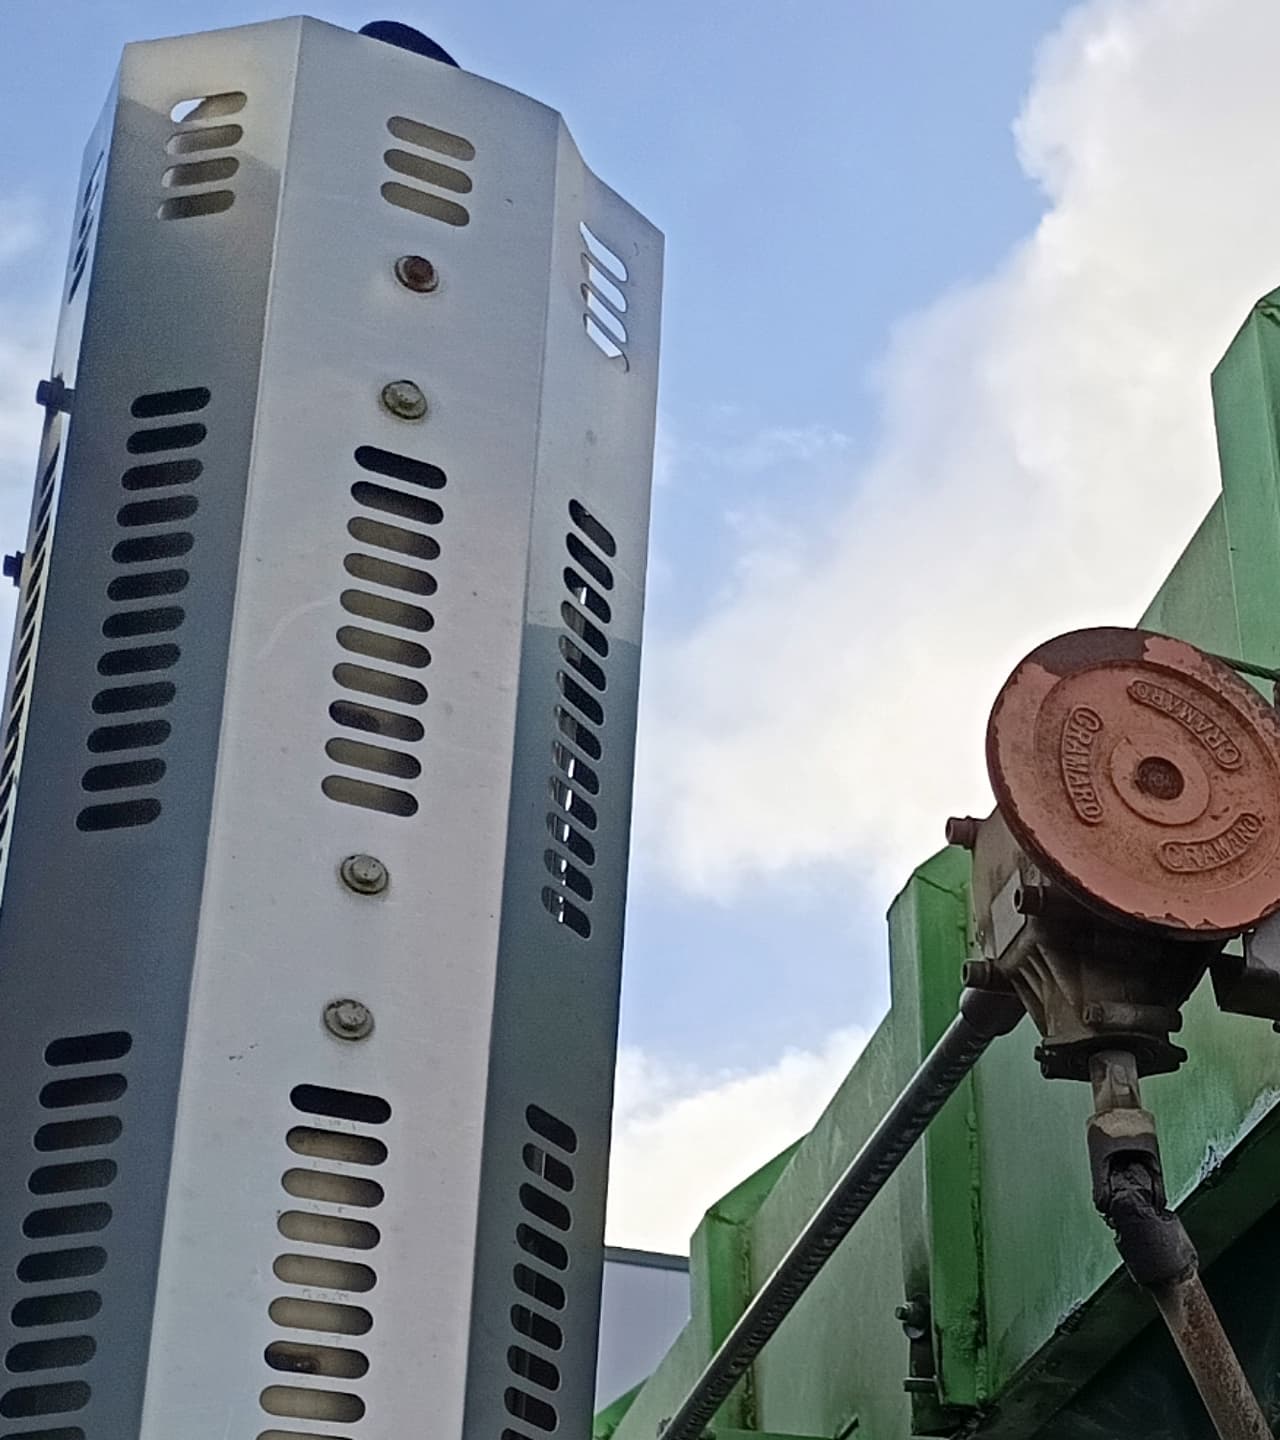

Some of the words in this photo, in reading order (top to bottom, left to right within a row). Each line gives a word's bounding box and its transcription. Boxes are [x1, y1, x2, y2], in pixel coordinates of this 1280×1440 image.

[1063, 707, 1102, 821] CRAMARO
[1134, 682, 1240, 766] CRAMARO
[1164, 814, 1262, 869] CRAMARO
